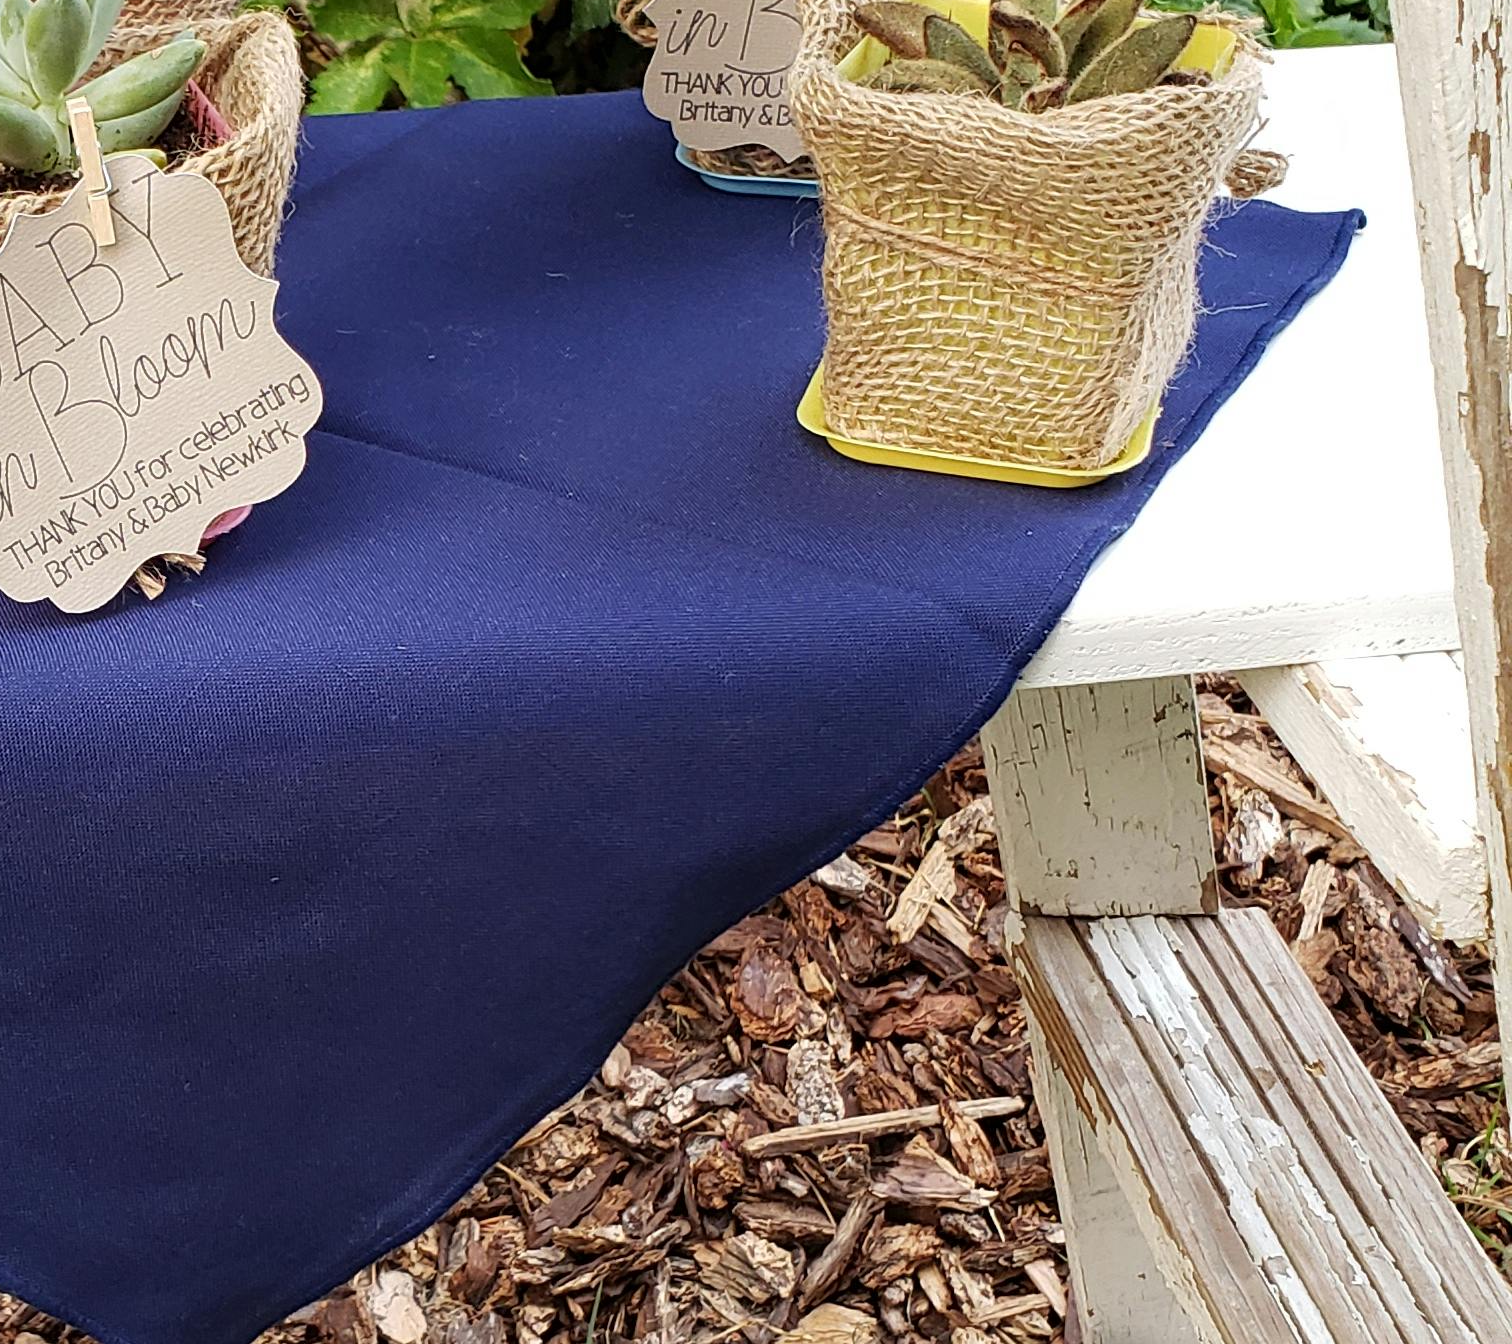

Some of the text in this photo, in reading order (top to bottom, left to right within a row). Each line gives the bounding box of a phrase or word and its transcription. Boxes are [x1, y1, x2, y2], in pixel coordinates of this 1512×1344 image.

[661, 72, 783, 98] THANK YOU
[665, 9, 728, 55] in
[680, 99, 755, 128] Britany
[759, 105, 773, 125] &
[27, 298, 256, 499] Bloom
[3, 373, 310, 570] THANK YOU for celebrating
[45, 420, 299, 587] Britany & Baby Newkirk
